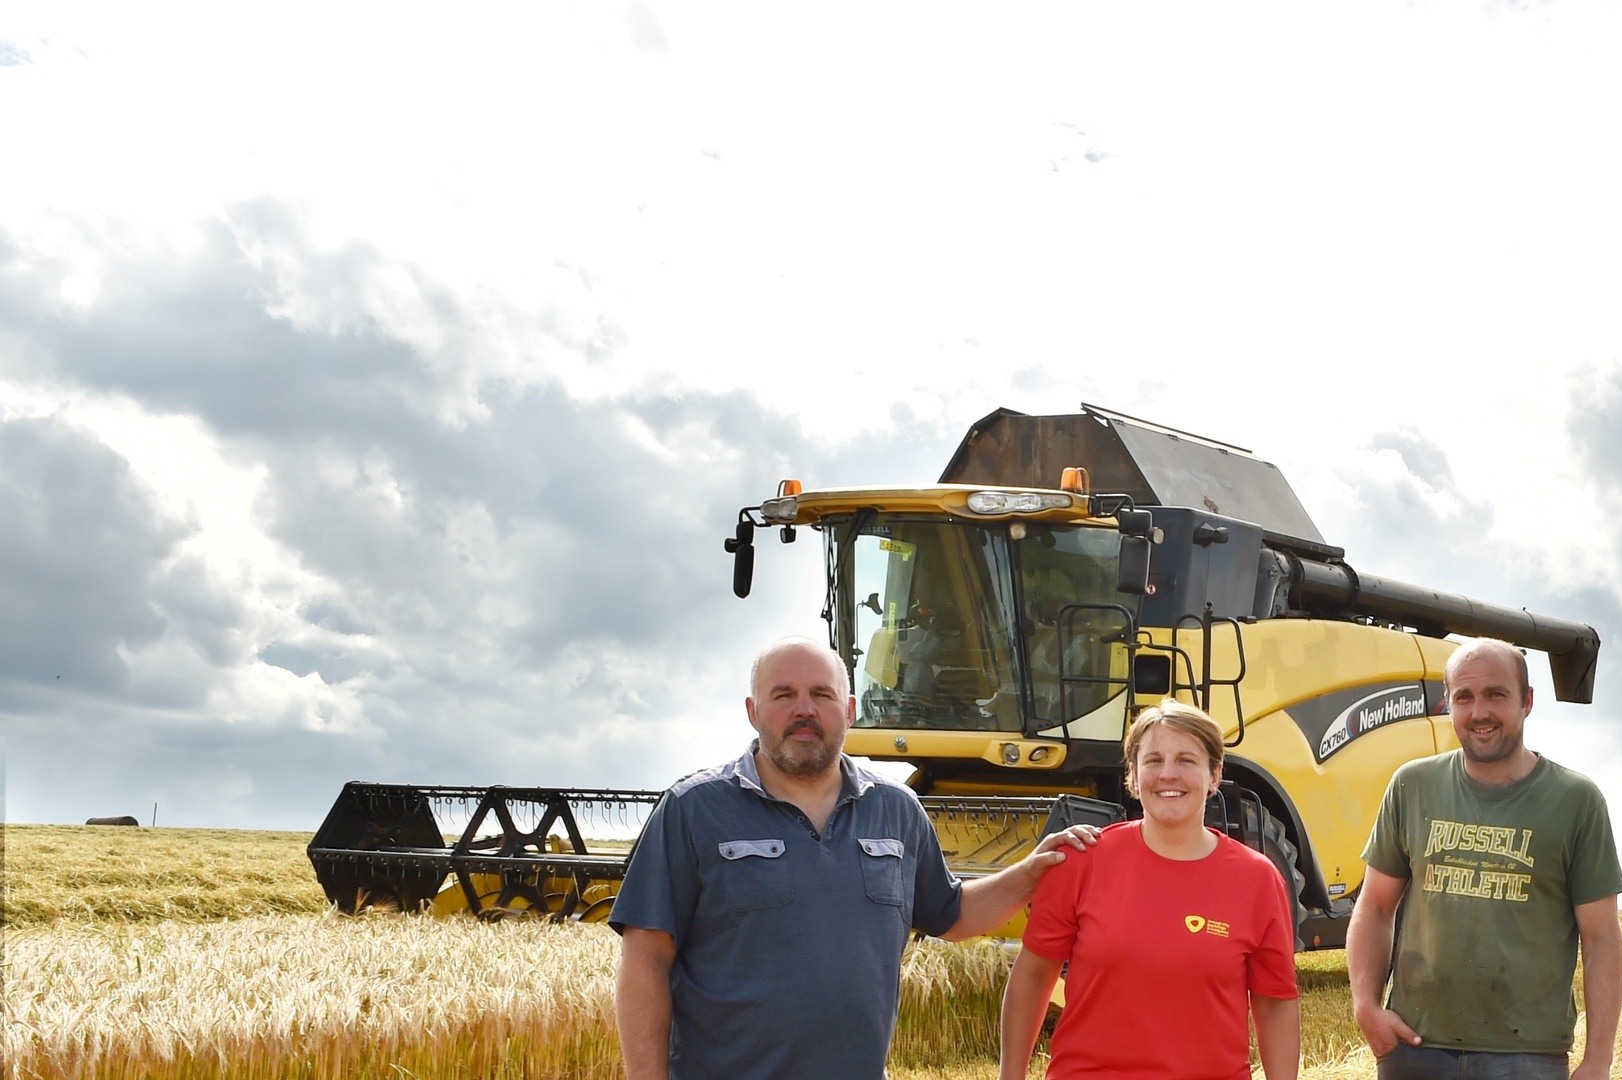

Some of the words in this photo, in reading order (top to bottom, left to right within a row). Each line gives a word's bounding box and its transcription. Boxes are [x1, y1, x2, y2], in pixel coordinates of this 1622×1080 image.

[1359, 707, 1385, 733] New
[1384, 694, 1425, 723] Holland
[1320, 727, 1346, 756] CX760
[1424, 820, 1535, 868] RUSSELL
[1424, 864, 1532, 902] ATHLETIC
